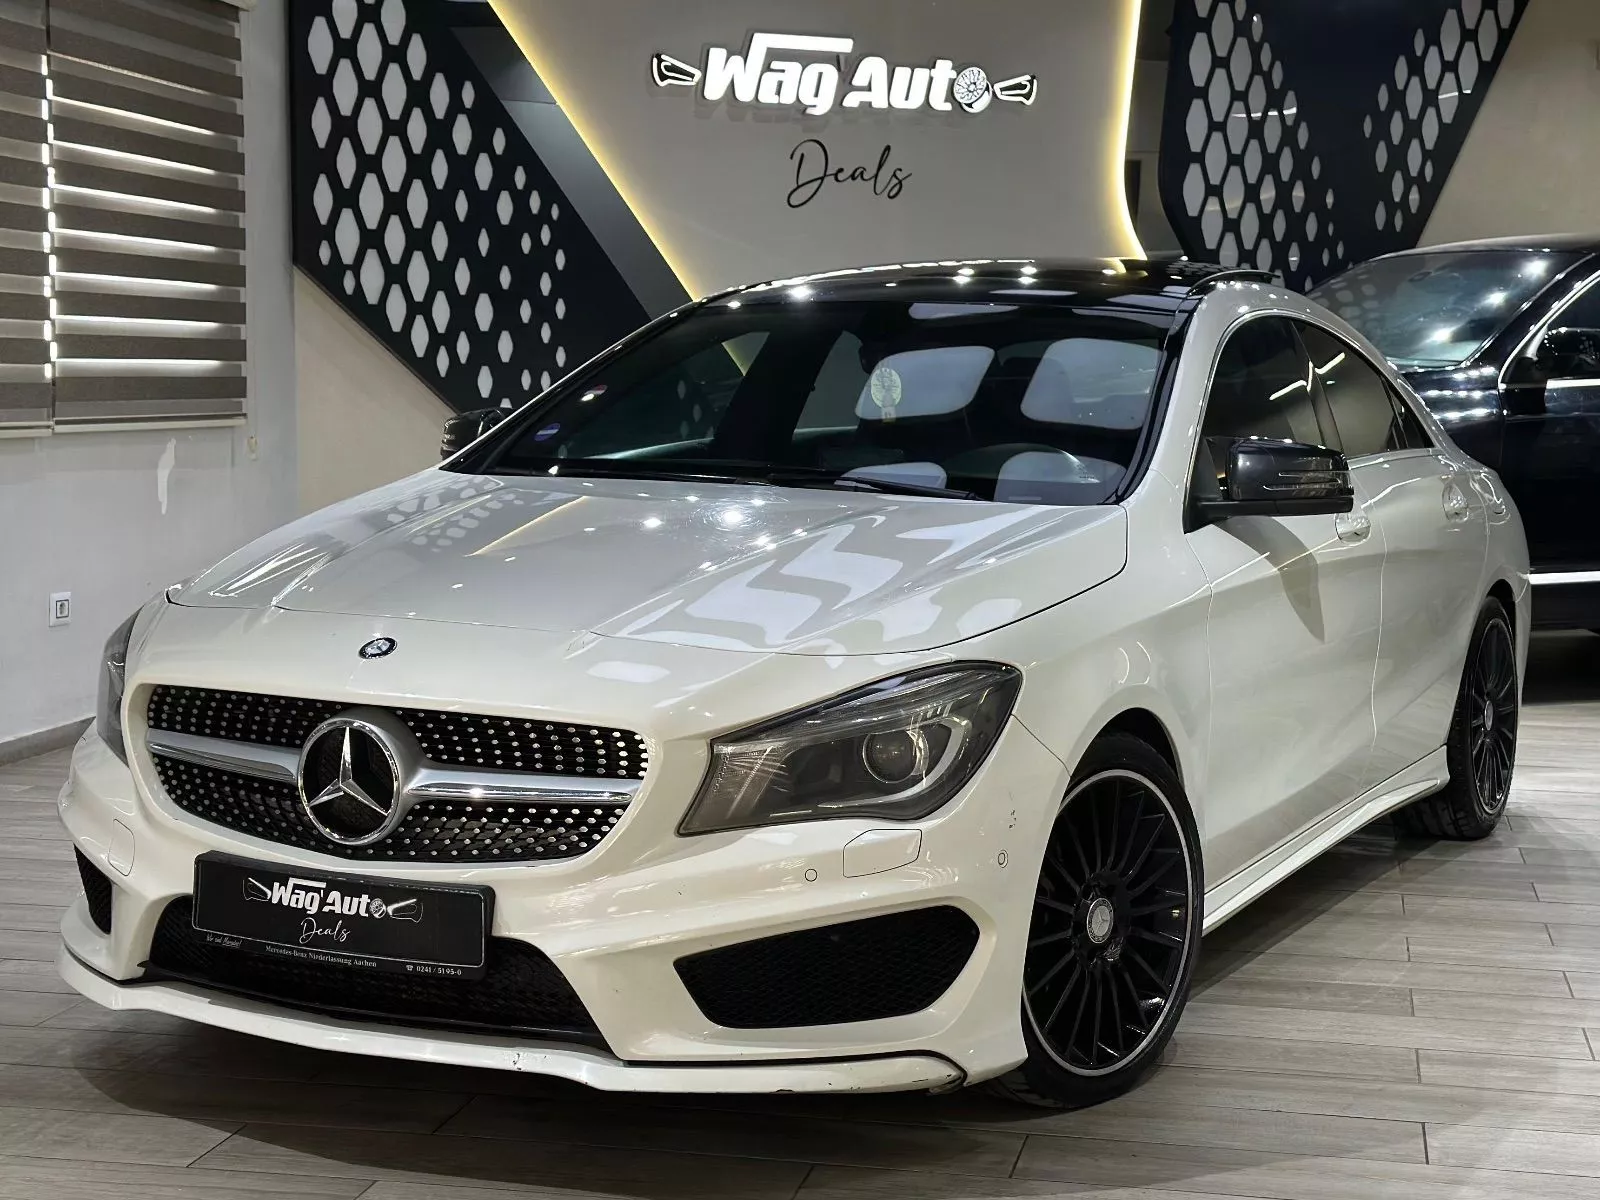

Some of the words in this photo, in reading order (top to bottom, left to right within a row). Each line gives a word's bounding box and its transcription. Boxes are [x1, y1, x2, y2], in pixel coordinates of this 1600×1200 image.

[786, 138, 913, 209] Deals
[298, 916, 351, 944] Deals
[265, 945, 308, 958] Mercedes-Benz
[308, 952, 352, 966] Niederlassung
[353, 958, 377, 968] Aachen
